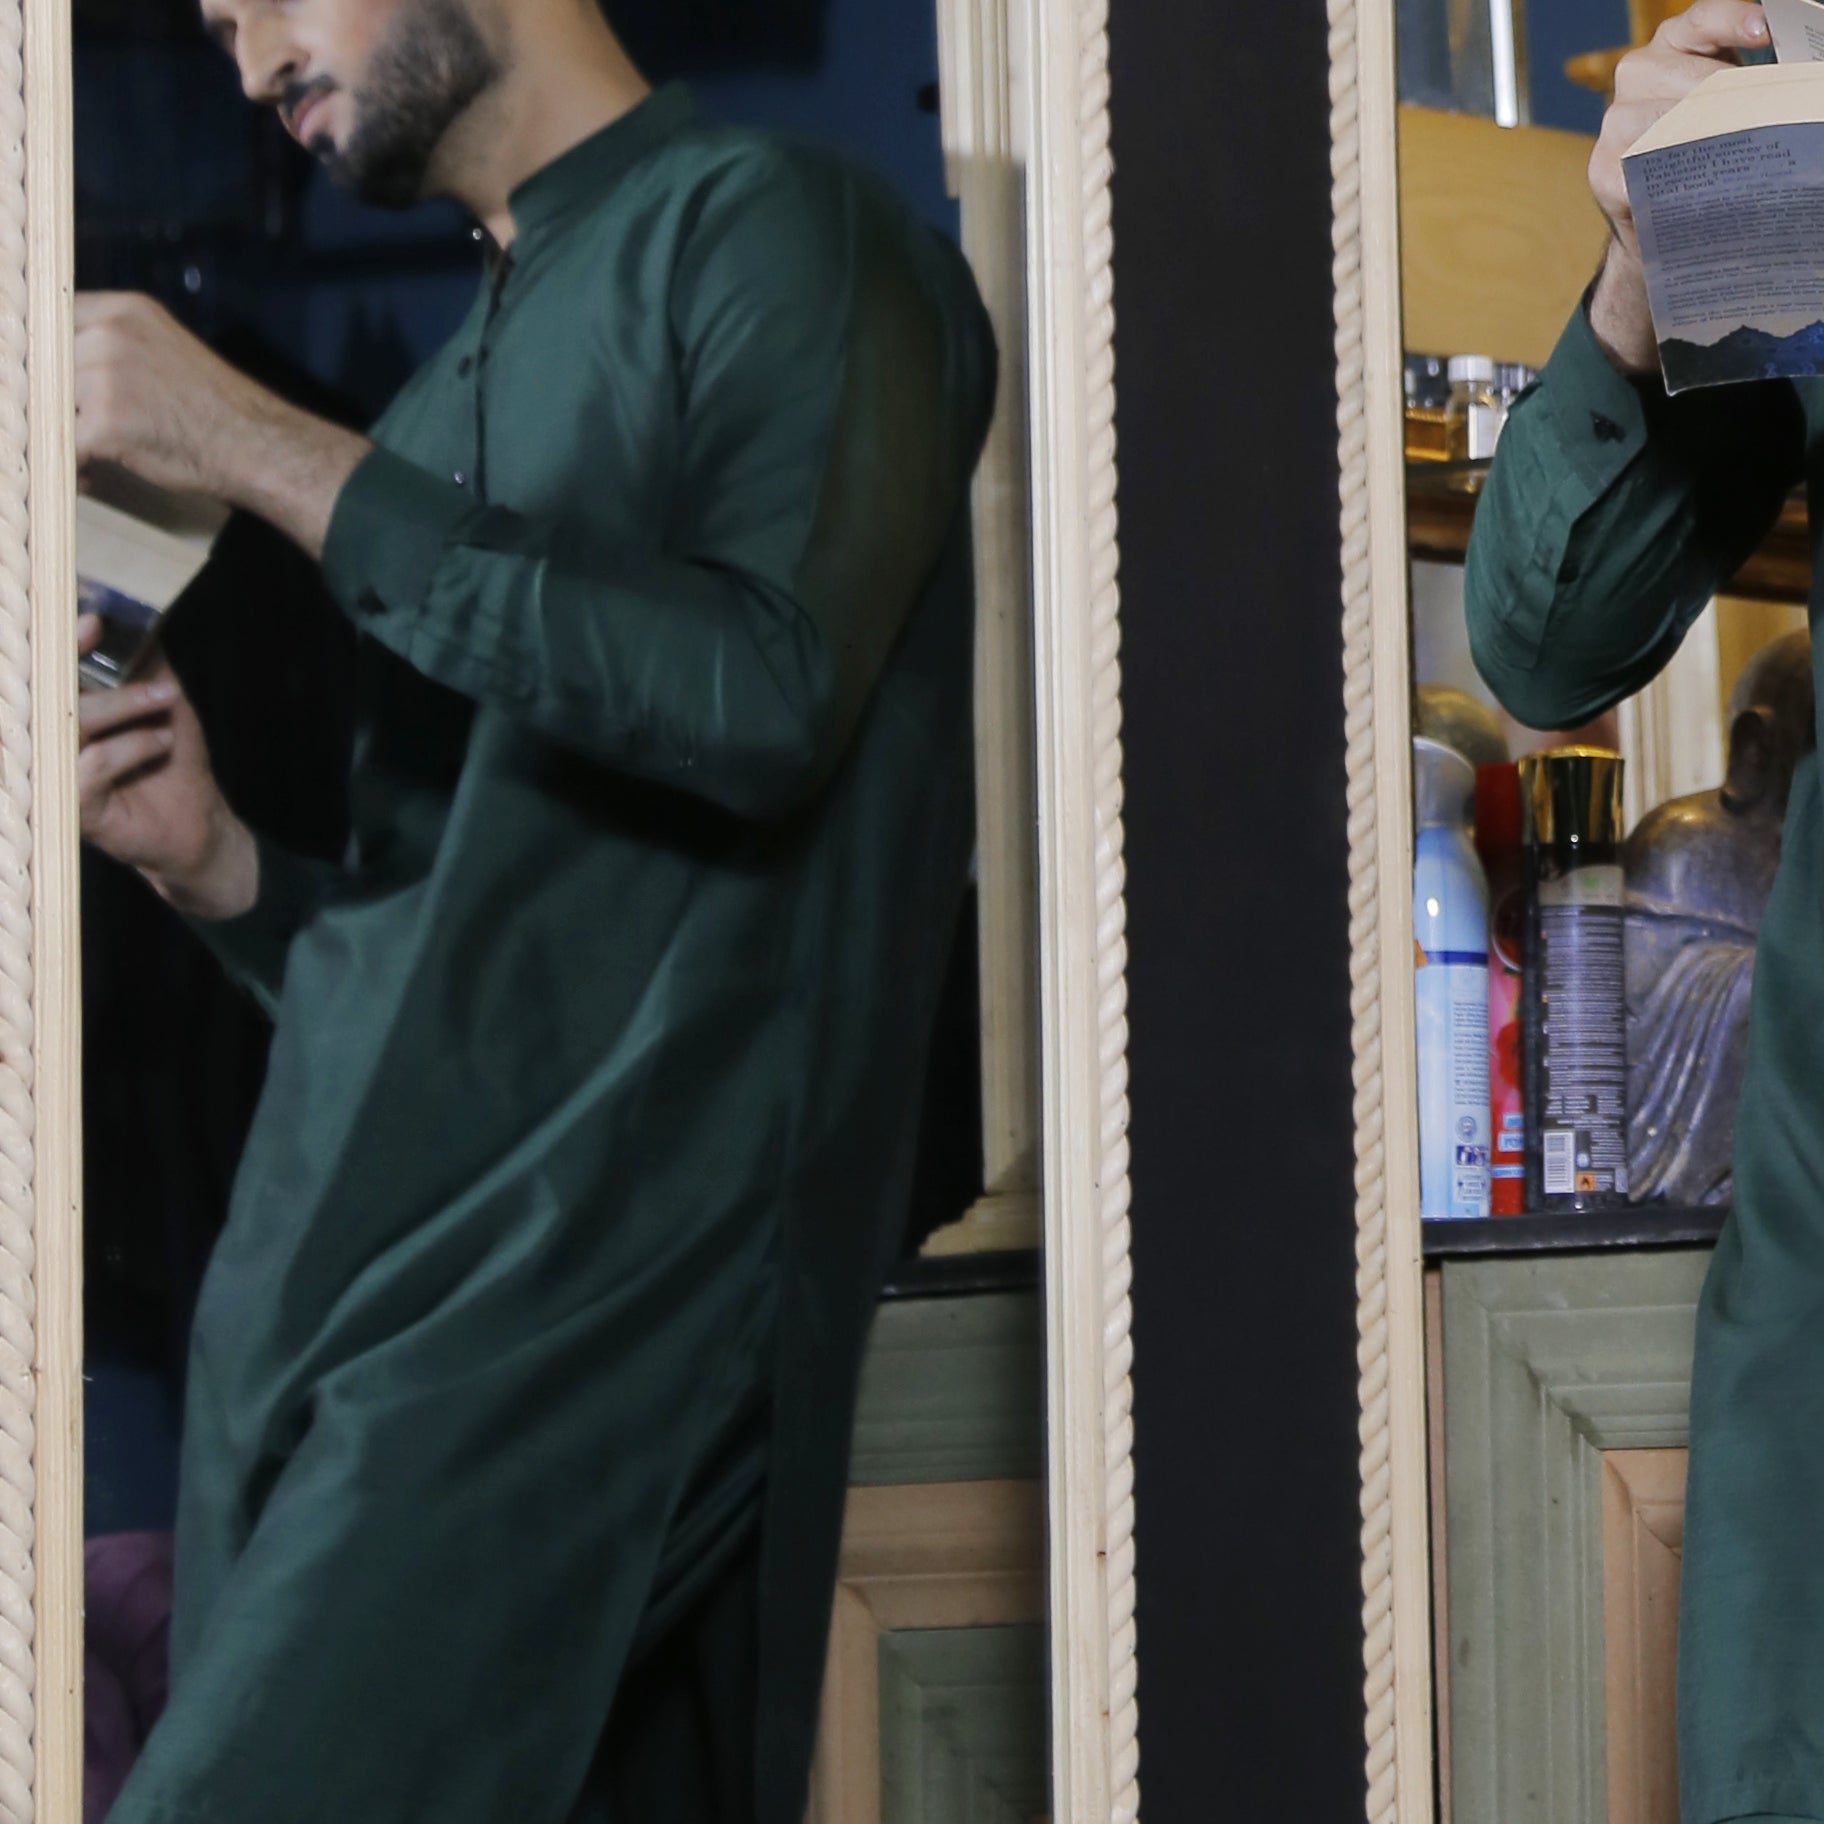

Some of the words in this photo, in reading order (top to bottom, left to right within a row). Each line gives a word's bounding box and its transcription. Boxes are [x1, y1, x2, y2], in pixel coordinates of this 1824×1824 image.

[1693, 145, 1715, 156] the
[1719, 137, 1752, 150] most
[1715, 144, 1763, 159] survey
[1766, 141, 1780, 151] of
[1645, 162, 1707, 182] Pakistan
[1722, 156, 1756, 167] have
[1760, 148, 1792, 161] read
